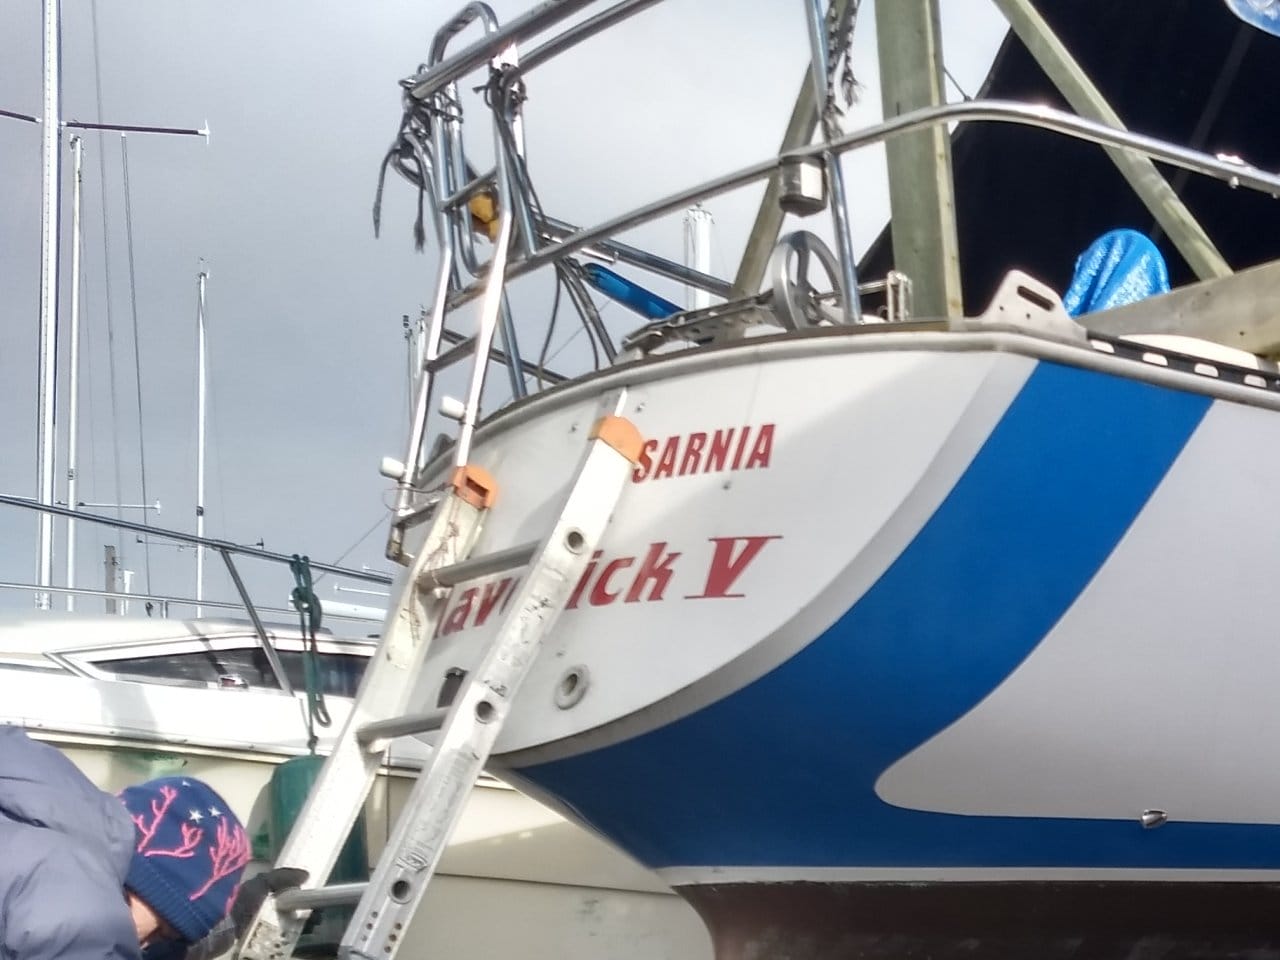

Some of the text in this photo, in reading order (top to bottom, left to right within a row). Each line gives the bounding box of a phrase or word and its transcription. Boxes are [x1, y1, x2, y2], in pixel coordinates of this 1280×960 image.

[632, 423, 777, 484] SARNIA
[433, 534, 784, 641] avick V
